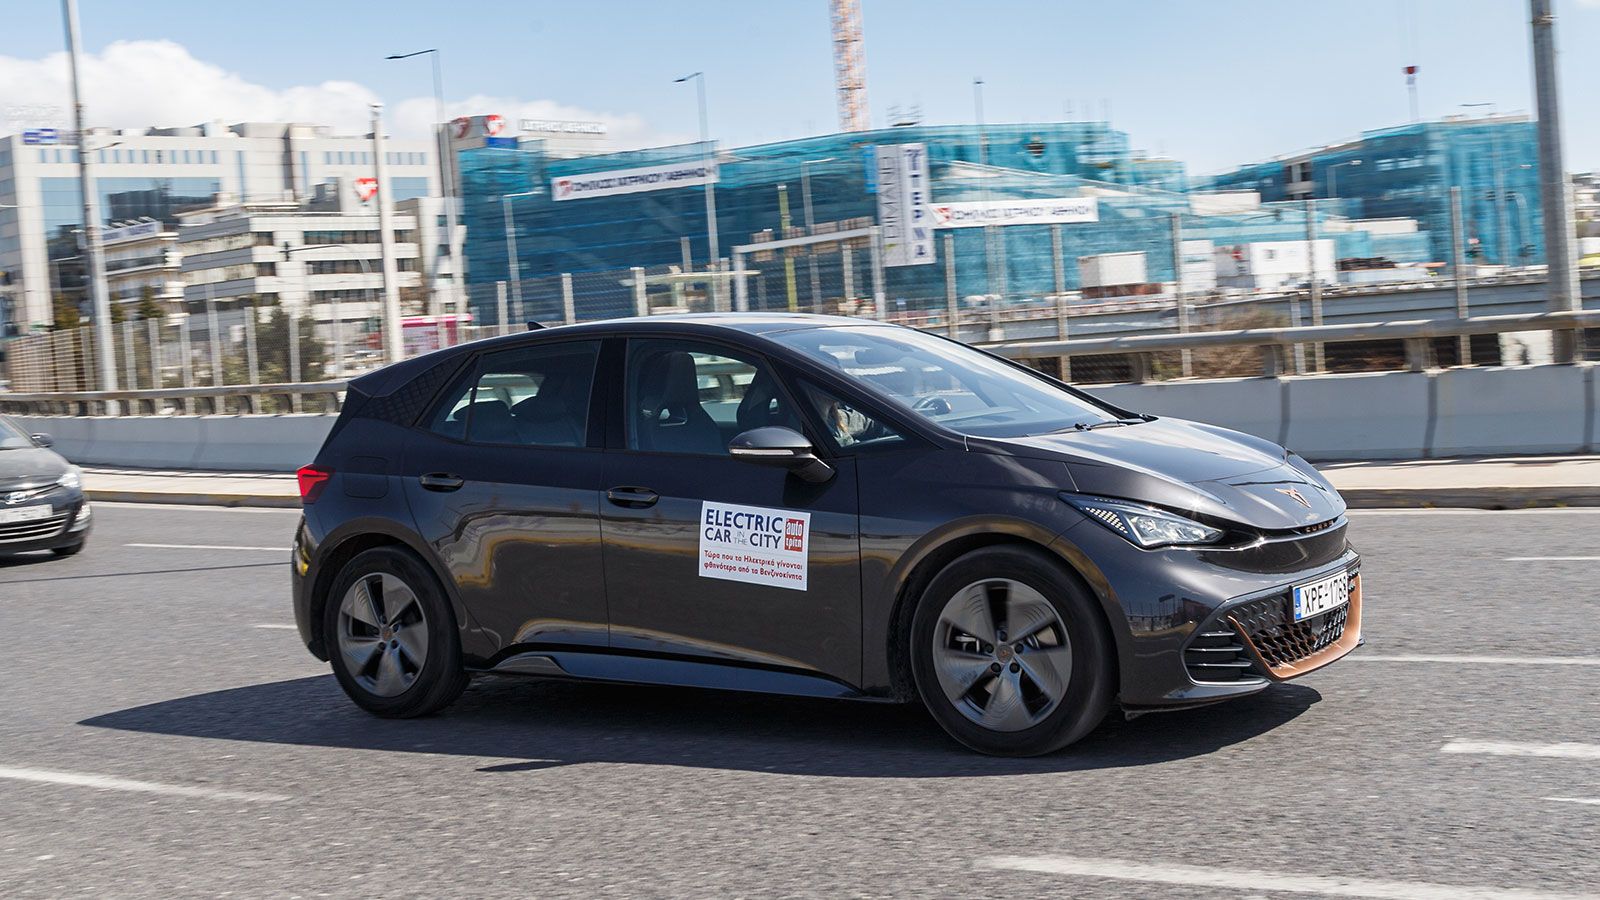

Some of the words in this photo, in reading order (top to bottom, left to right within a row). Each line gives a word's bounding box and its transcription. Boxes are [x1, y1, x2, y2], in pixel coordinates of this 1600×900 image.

[705, 508, 783, 534] ELECTRIC
[704, 527, 732, 543] CAR
[749, 533, 782, 549] CITY
[733, 537, 748, 546] THE
[704, 549, 721, 560] Τώρα
[744, 555, 775, 567] Ηλεκτρικά
[776, 560, 803, 570] γίνονται
[703, 561, 736, 573] φθηνότερα
[738, 566, 750, 574] από
[759, 568, 803, 581] Βενζινοκίνητα
